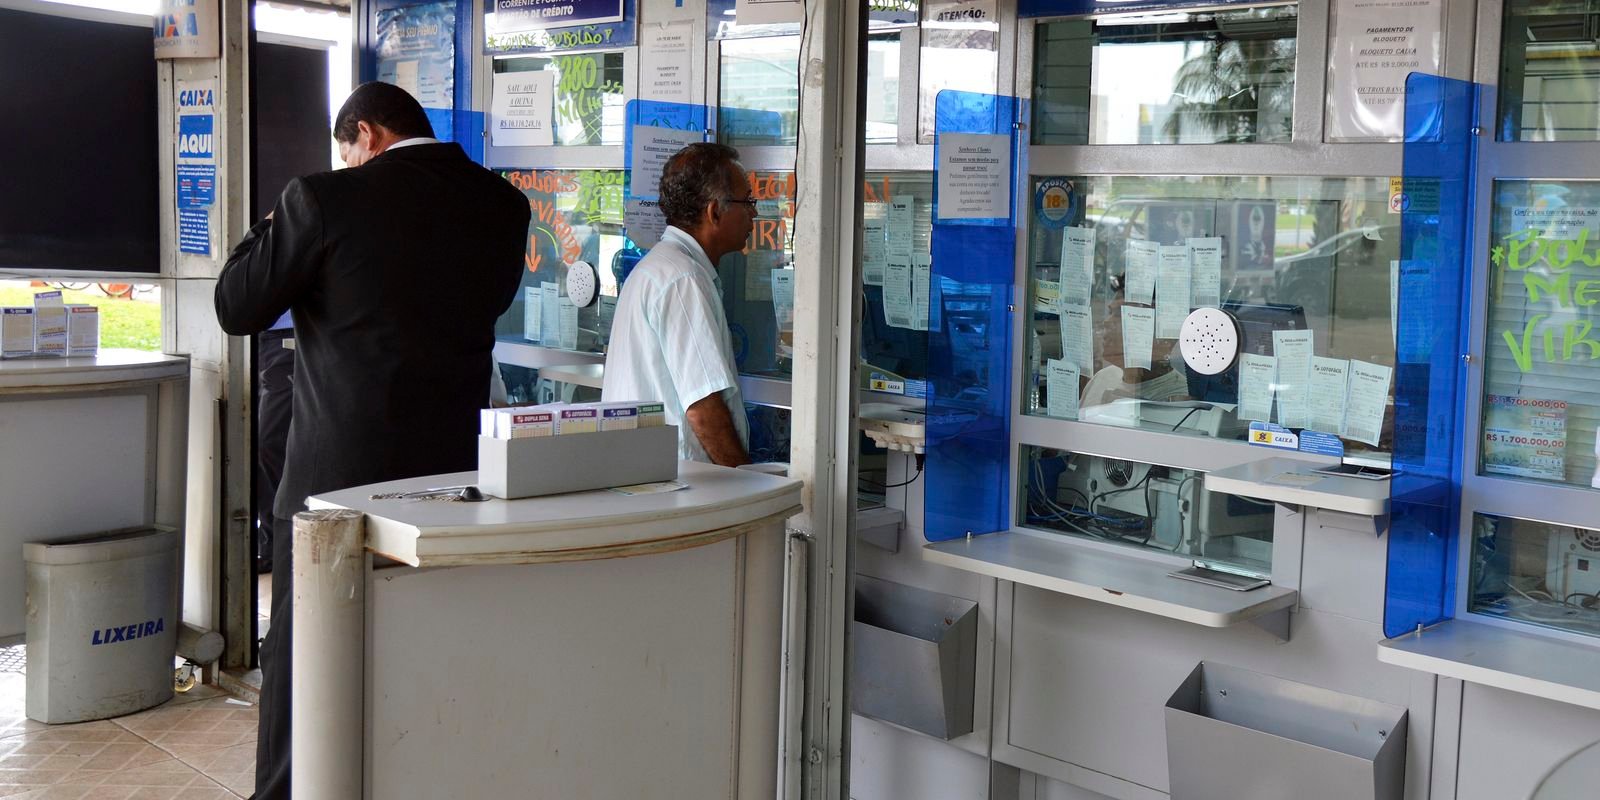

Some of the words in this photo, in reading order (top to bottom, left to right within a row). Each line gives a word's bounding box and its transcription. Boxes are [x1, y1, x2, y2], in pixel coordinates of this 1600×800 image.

[542, 5, 574, 17] CRÉDITO
[937, 7, 986, 21] ATENÇÃO:
[559, 56, 597, 97] 280
[180, 89, 213, 106] CAIXA
[180, 134, 212, 154] AQUI
[1041, 180, 1072, 193] APOSTAR
[1502, 314, 1600, 373] VIR
[1486, 433, 1498, 442] R$
[1501, 435, 1564, 448] 1.700.000,00
[91, 617, 165, 645] LIXEIRA
